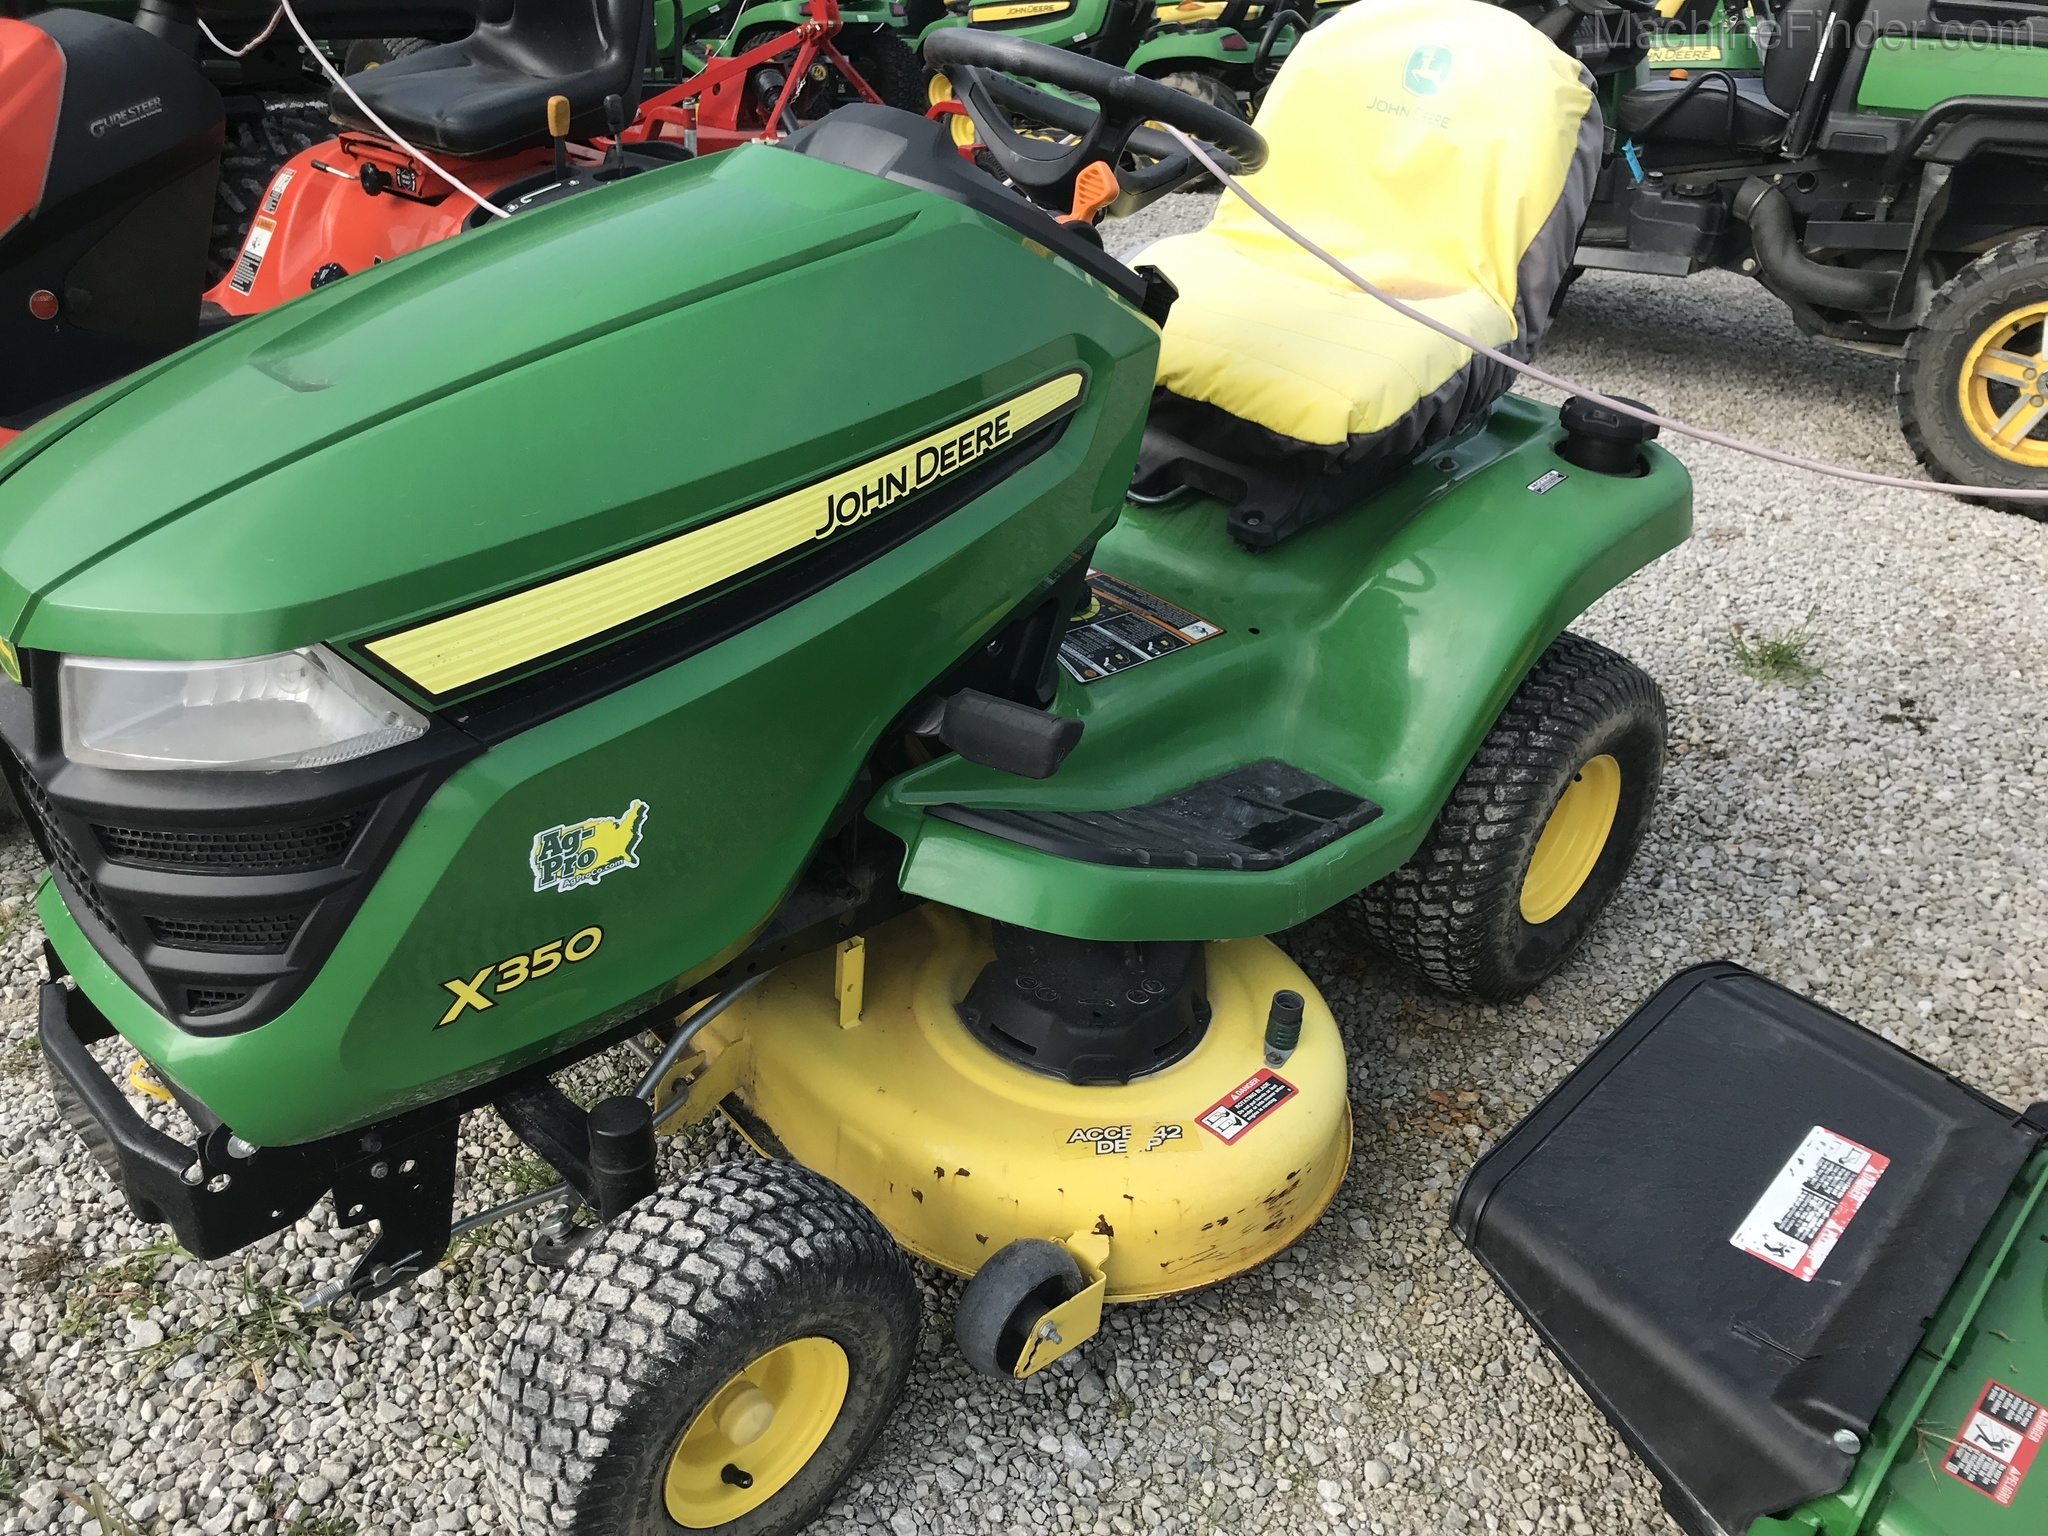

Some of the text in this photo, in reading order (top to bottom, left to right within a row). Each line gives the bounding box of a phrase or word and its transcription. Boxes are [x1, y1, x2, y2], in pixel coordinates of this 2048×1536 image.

[1007, 4, 1054, 15] JOHN DEERE
[1665, 49, 1711, 60] DEERE
[1366, 96, 1411, 118] JOHN
[815, 410, 1011, 538] JOHN DEERE
[539, 847, 598, 888] Pro
[562, 859, 625, 888] AgProCo.com
[433, 925, 603, 1030] X350
[1235, 1077, 1261, 1096] DANGER
[1066, 1124, 1183, 1144] ACCE 42
[1095, 1137, 1163, 1155] DEP
[2028, 1414, 2048, 1443] DANGER
[1996, 1472, 2020, 1504] PELIGRO
